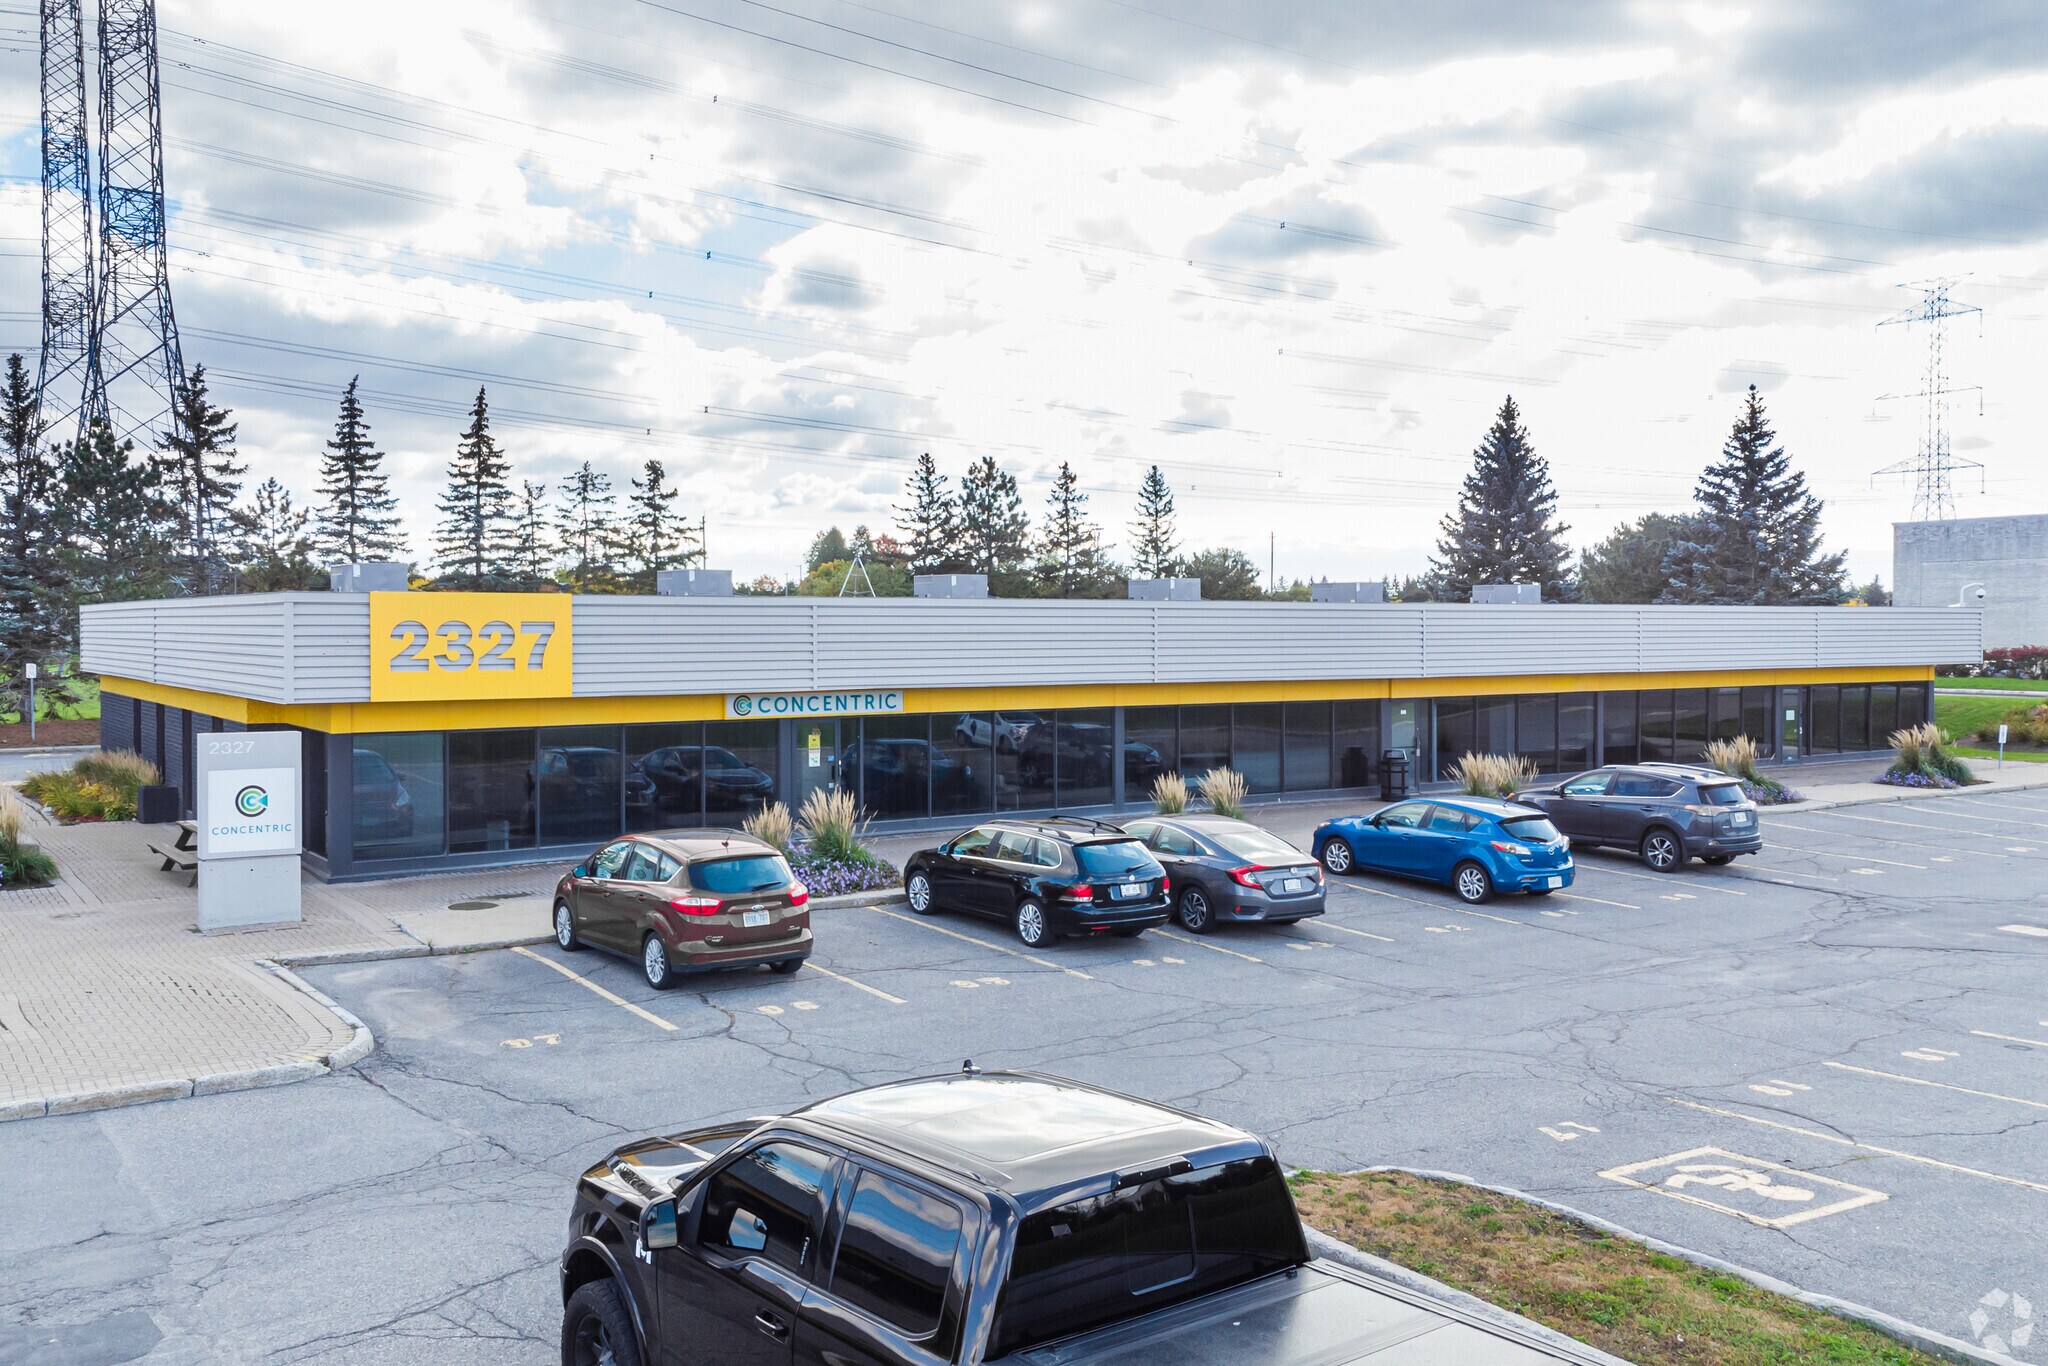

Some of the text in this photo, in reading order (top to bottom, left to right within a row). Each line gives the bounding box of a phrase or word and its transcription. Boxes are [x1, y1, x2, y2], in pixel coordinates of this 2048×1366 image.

[390, 620, 556, 672] 2327
[757, 693, 897, 714] CONCENTRIC
[209, 741, 255, 754] 2327
[212, 824, 292, 835] CONCENTRIC
